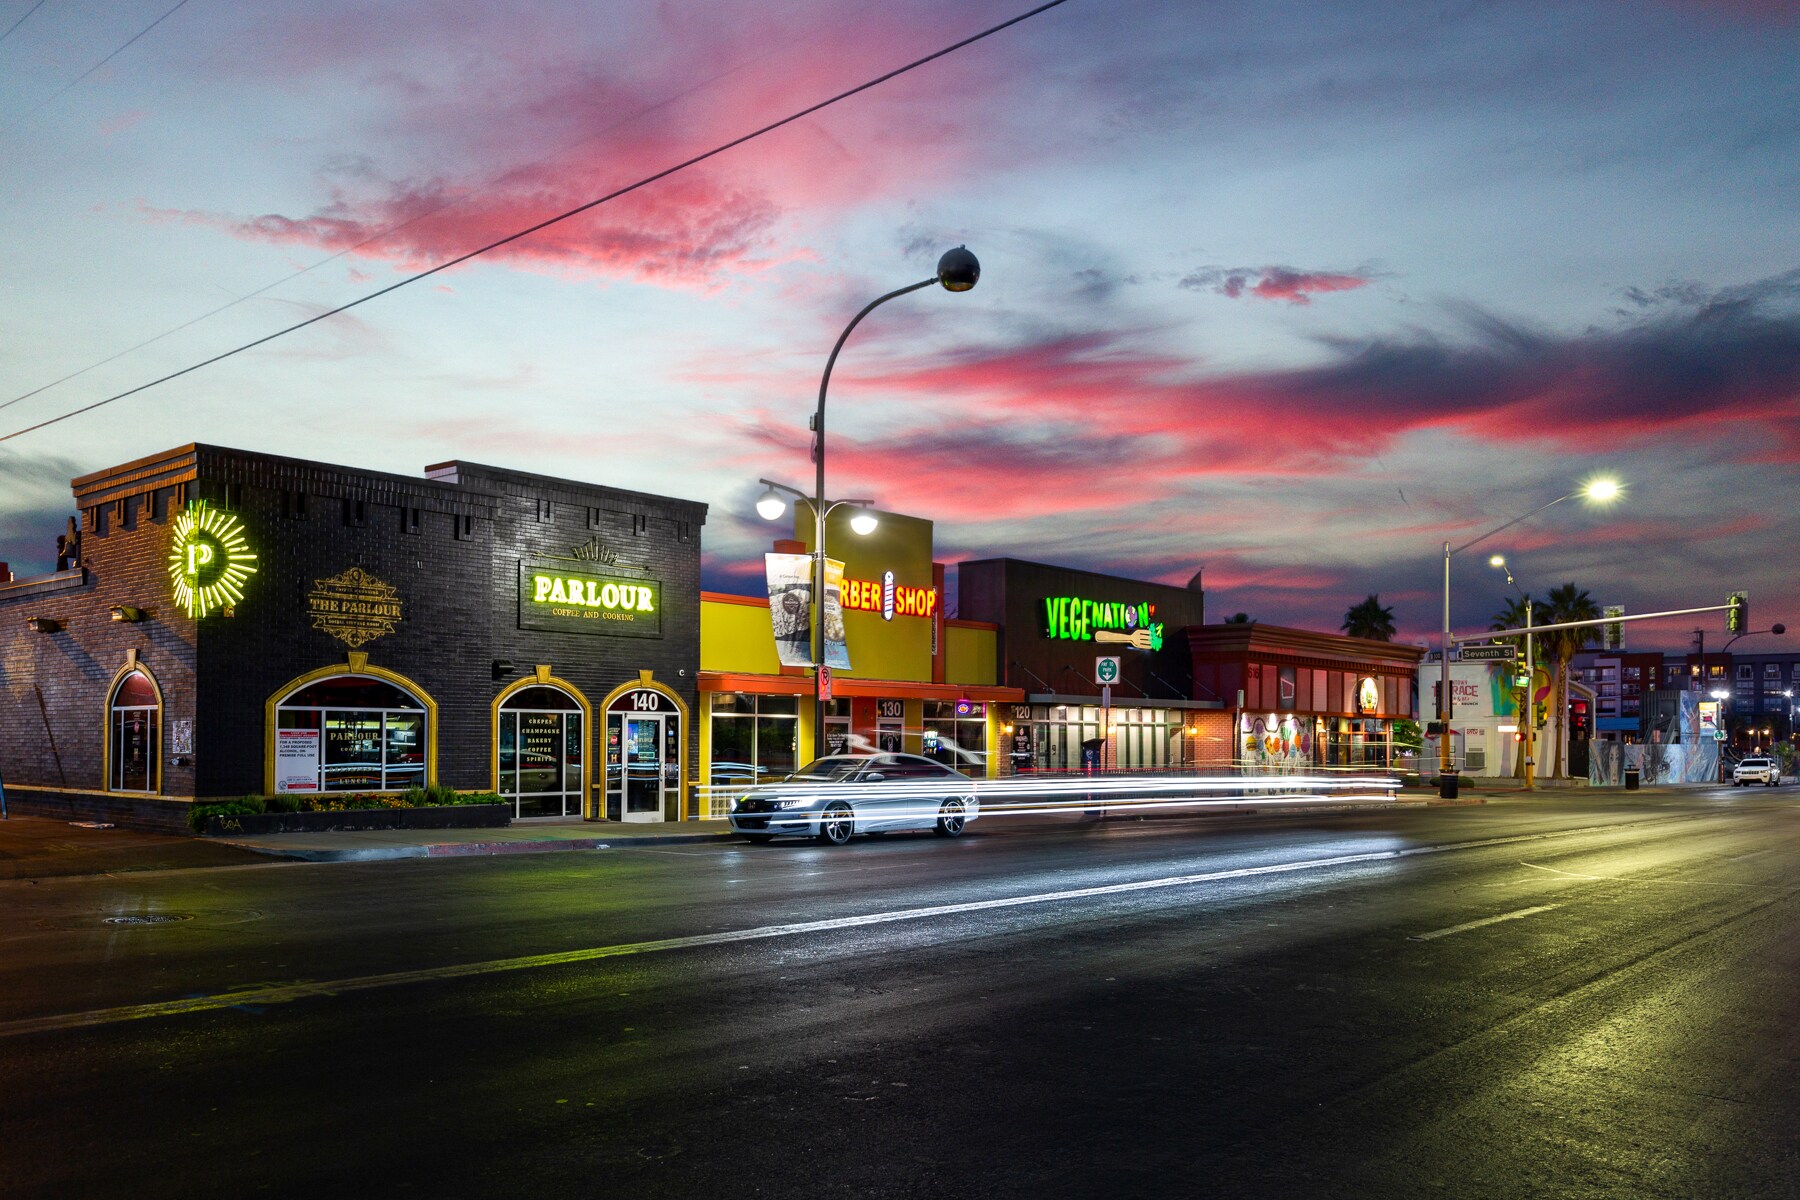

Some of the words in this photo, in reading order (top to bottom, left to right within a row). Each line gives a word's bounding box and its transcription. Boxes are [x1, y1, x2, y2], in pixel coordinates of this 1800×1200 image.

[187, 544, 212, 574] P
[534, 575, 654, 612] PARLOUR
[839, 579, 882, 611] RBER
[895, 586, 936, 617] SHOP
[310, 599, 339, 611] THE
[342, 601, 401, 617] PARLOUR
[552, 608, 580, 617] COFFEE
[583, 610, 599, 618] AND
[602, 612, 634, 621] COOKING
[1046, 597, 1150, 640] VEGENATION
[1464, 648, 1499, 657] Seventh
[1432, 685, 1478, 697] TRACE
[631, 693, 658, 711] 140
[882, 702, 901, 716] 130
[1015, 706, 1030, 719] 120
[330, 732, 378, 740] PARLOUR
